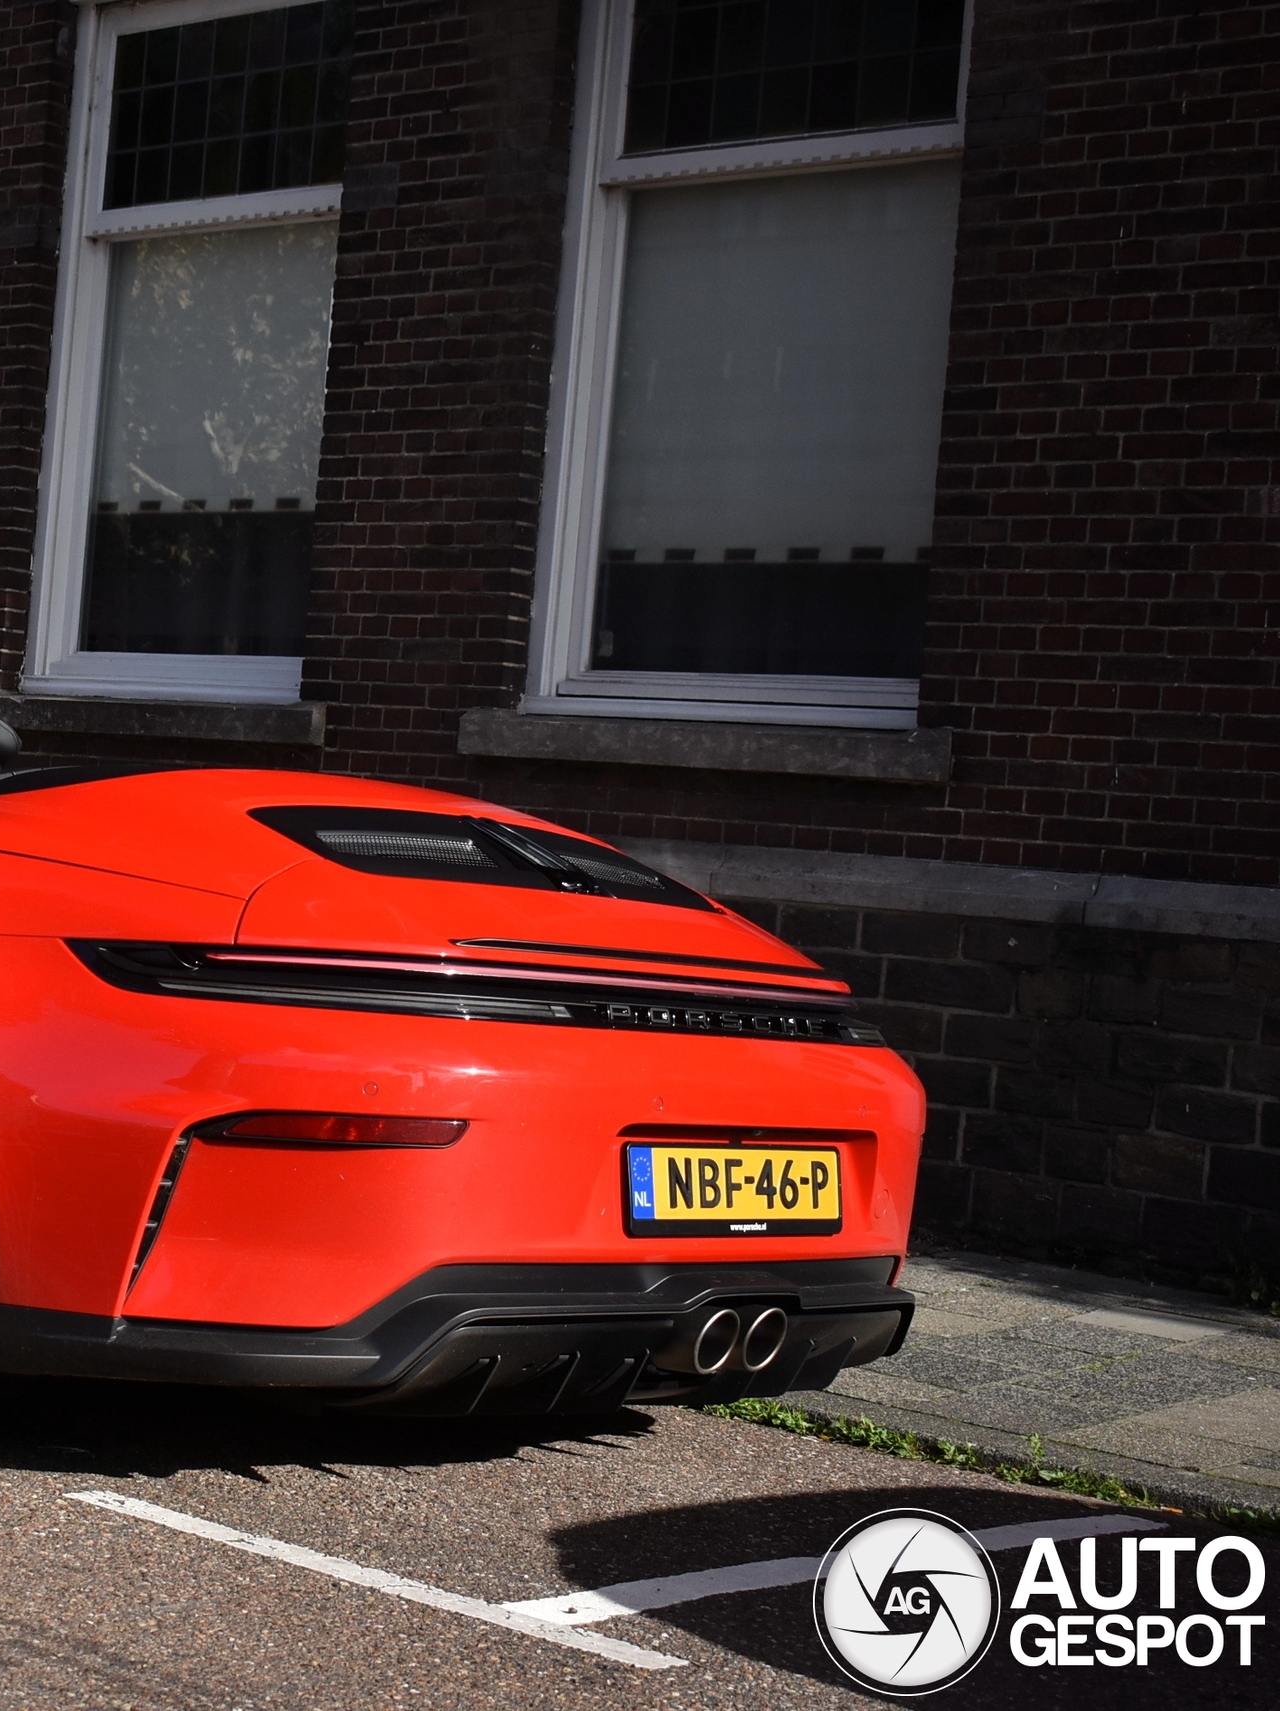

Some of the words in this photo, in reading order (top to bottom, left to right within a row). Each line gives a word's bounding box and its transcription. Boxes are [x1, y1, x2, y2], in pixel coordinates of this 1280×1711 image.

[608, 1003, 824, 1035] PORSCHE
[668, 1157, 829, 1209] NBF-46-P
[634, 1191, 651, 1207] NL
[730, 1222, 767, 1232] www.porsche.nl
